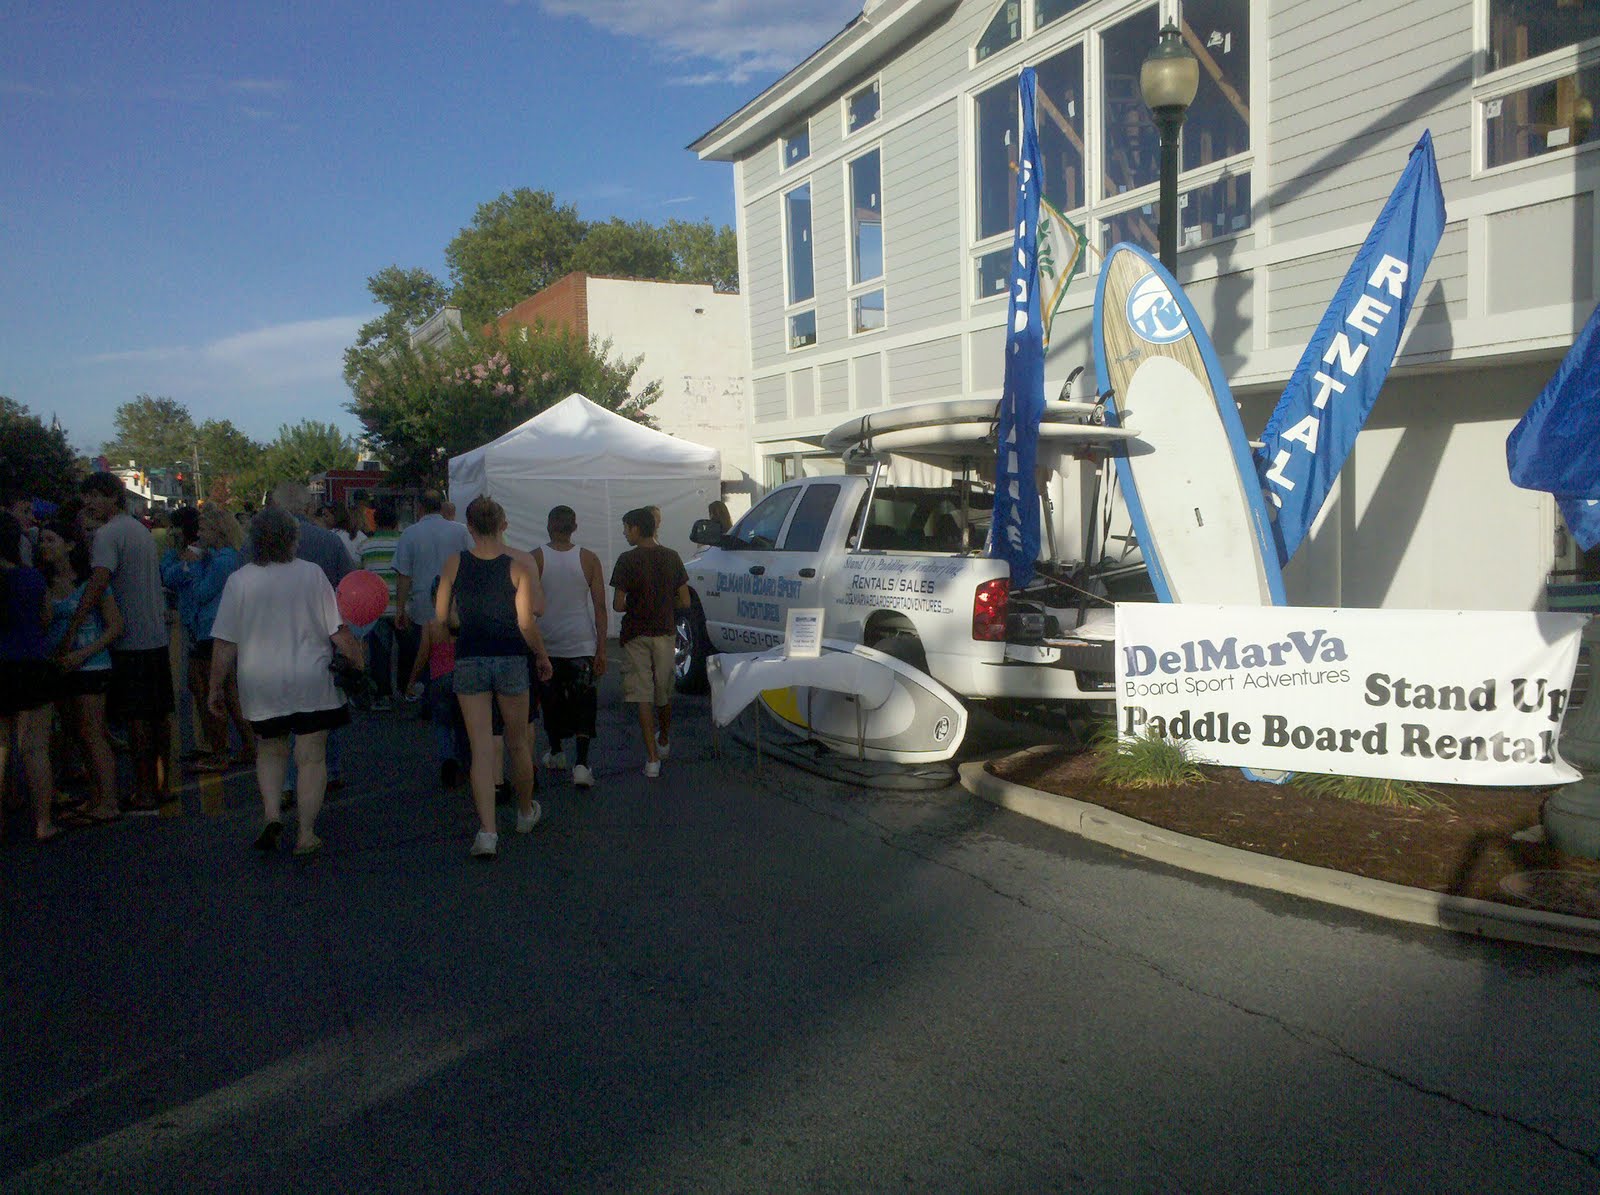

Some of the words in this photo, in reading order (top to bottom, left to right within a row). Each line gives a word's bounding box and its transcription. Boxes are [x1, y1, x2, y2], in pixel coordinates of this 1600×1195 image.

[720, 627, 785, 648] 301-651-05
[1123, 629, 1349, 677] DelMarVa
[1125, 678, 1179, 698] Board
[1184, 674, 1235, 697] Sport
[1243, 668, 1351, 690] Adventures
[1364, 672, 1497, 712] Stand
[1511, 678, 1568, 722] Up
[1123, 705, 1251, 745] Paddle
[1262, 714, 1389, 753] Board
[1400, 723, 1556, 764] Rental
